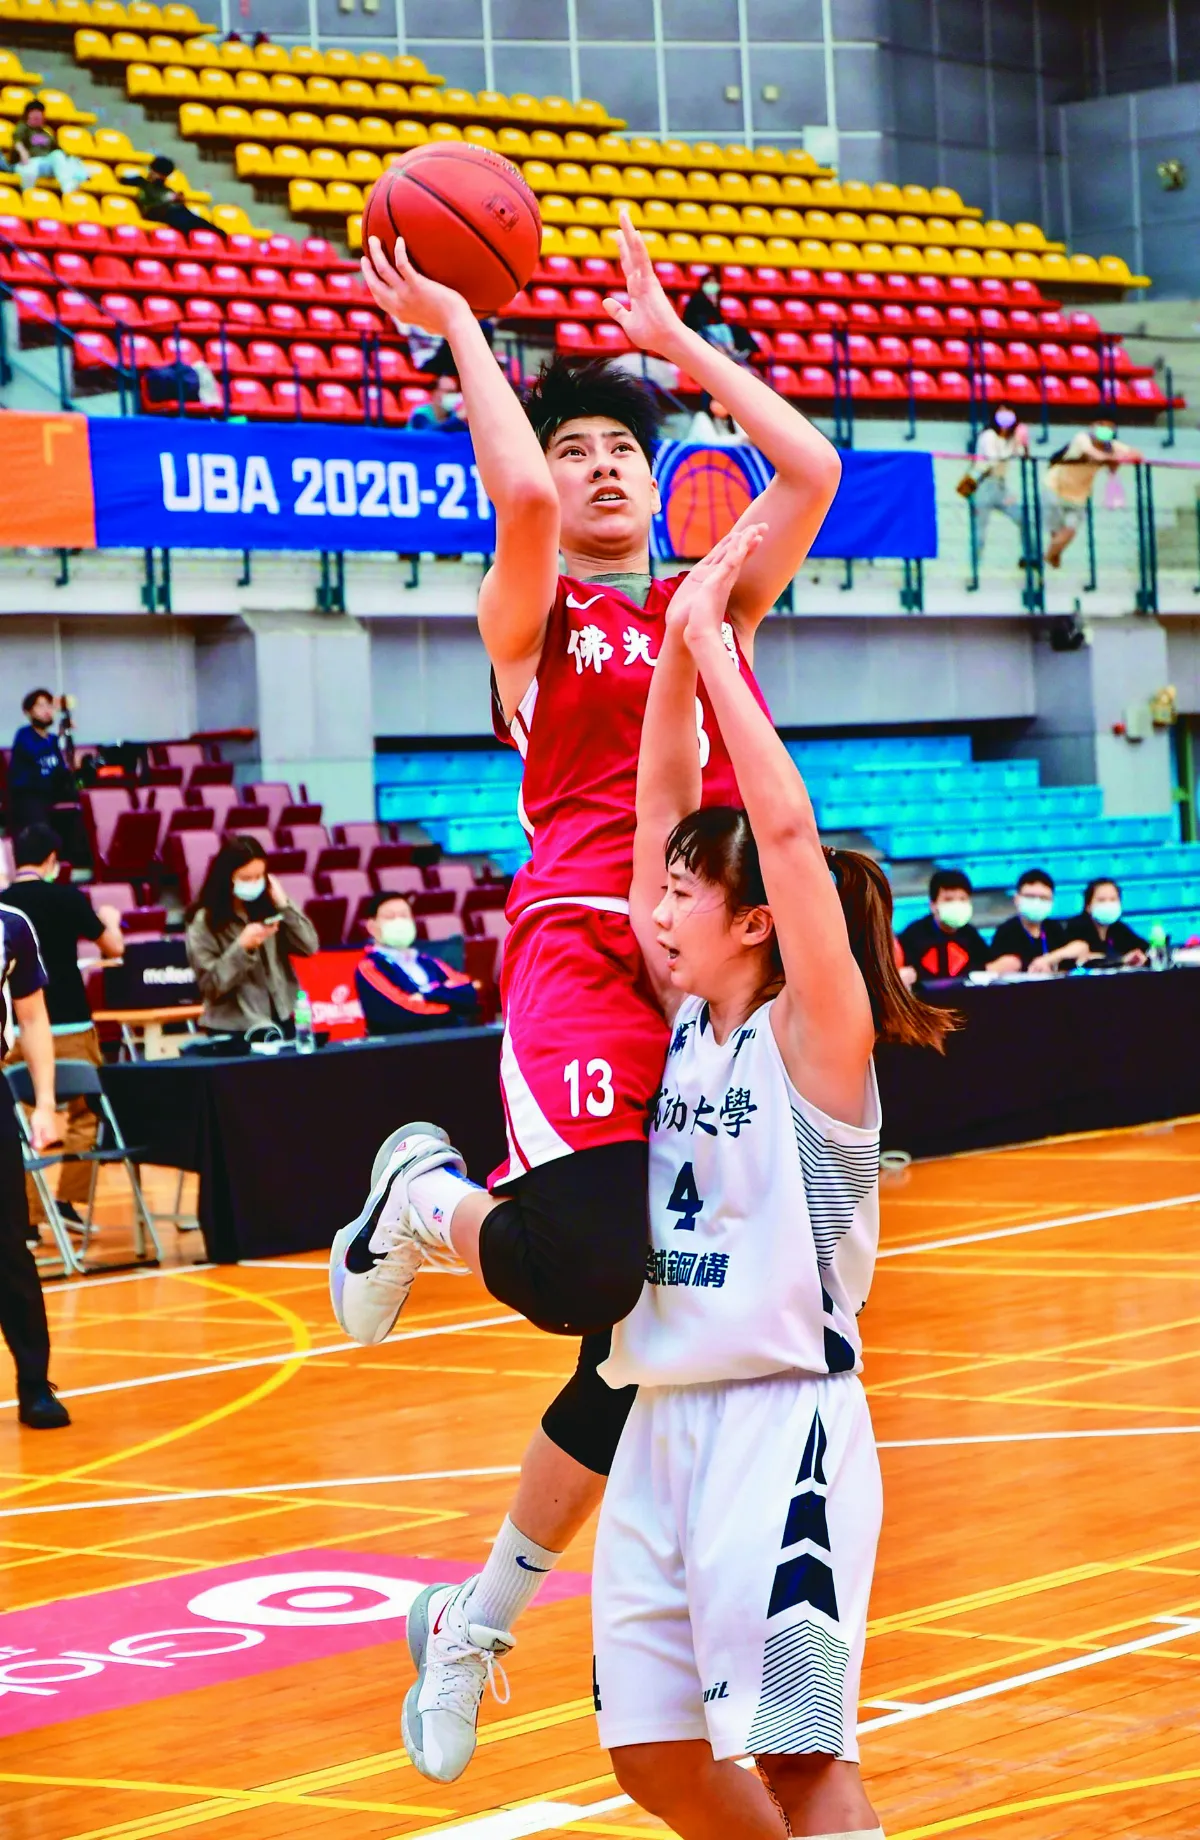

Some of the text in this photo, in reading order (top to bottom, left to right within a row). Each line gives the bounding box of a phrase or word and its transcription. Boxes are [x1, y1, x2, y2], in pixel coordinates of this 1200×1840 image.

[160, 452, 491, 520] UBA 2020-21
[563, 1057, 615, 1118] 13
[666, 1161, 704, 1231] 4
